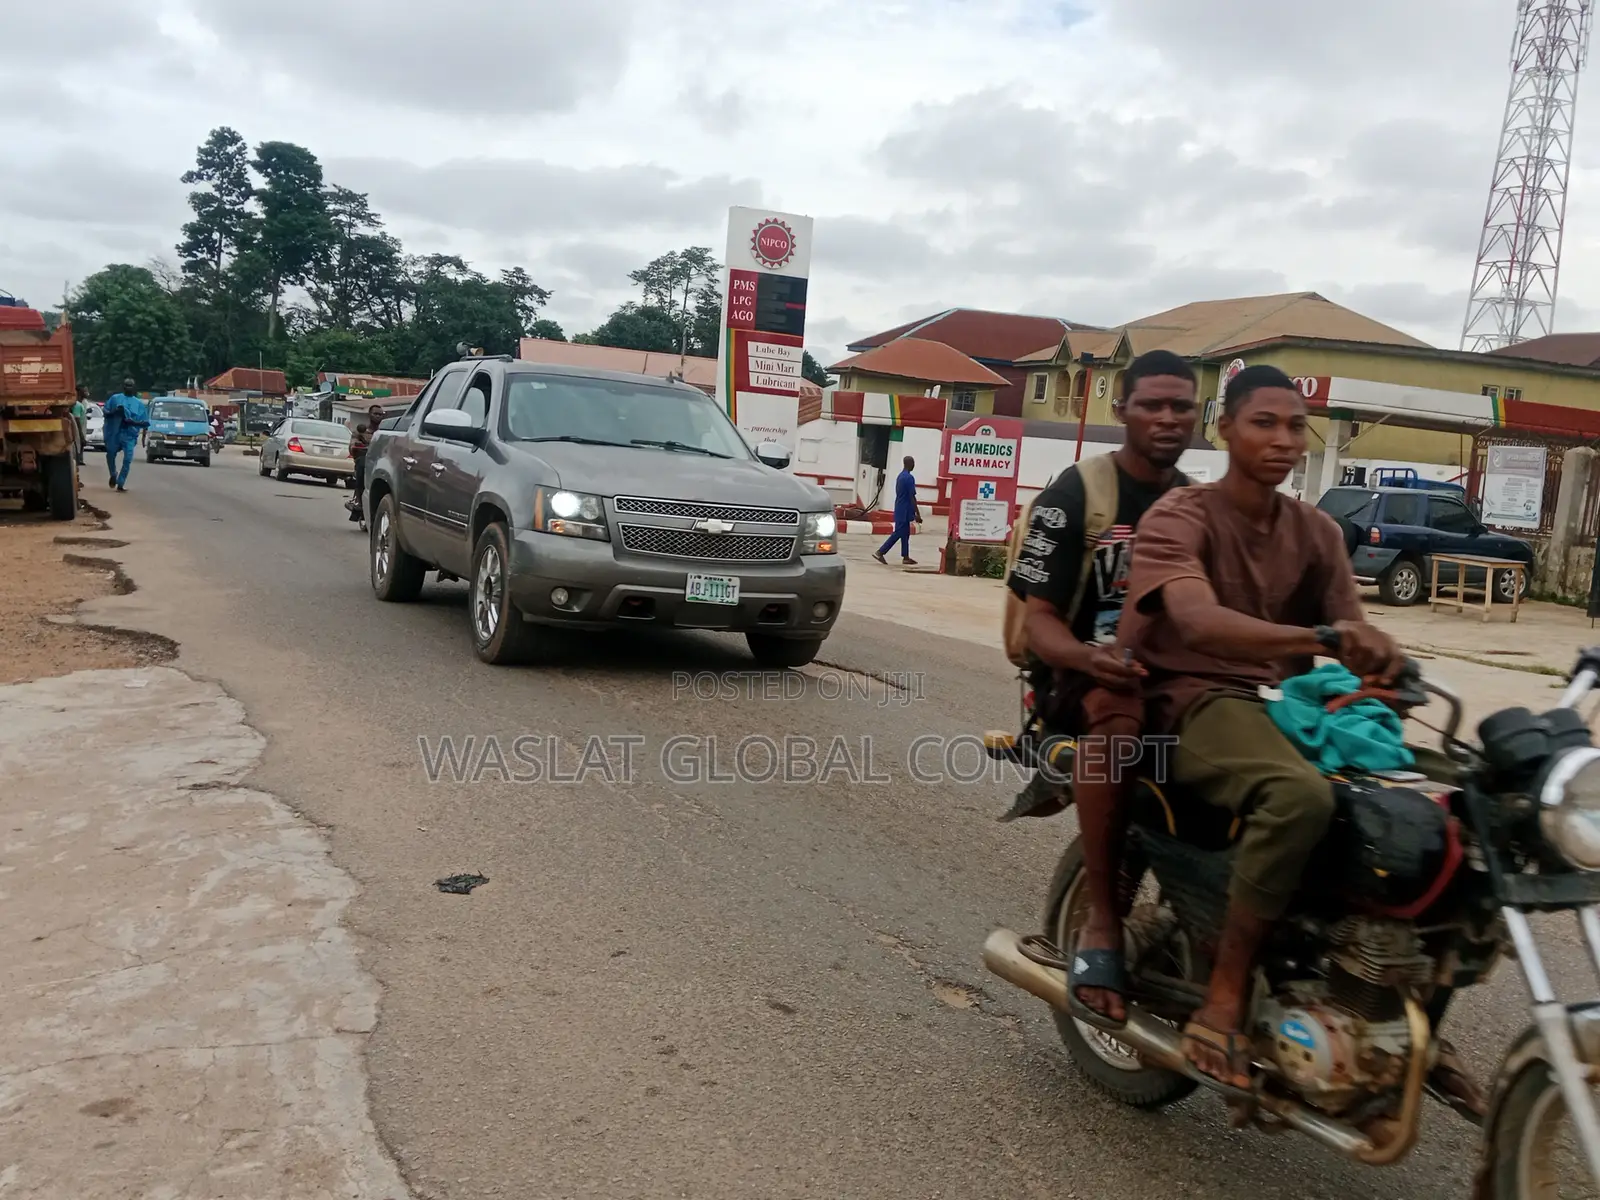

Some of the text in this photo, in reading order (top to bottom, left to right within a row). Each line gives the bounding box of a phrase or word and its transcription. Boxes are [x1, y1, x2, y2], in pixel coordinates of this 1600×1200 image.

[760, 237, 787, 249] NIPCO
[733, 279, 756, 292] PMS
[732, 296, 752, 306] LPG
[731, 310, 754, 321] AGO
[755, 345, 791, 358] Lube Bay
[754, 360, 795, 373] Mini Mart
[756, 376, 796, 389] Lubricant
[348, 388, 374, 396] FOAM
[751, 426, 788, 435] partnership
[954, 441, 1013, 457] BAYMEDICS
[954, 457, 1011, 470] PHARMACY
